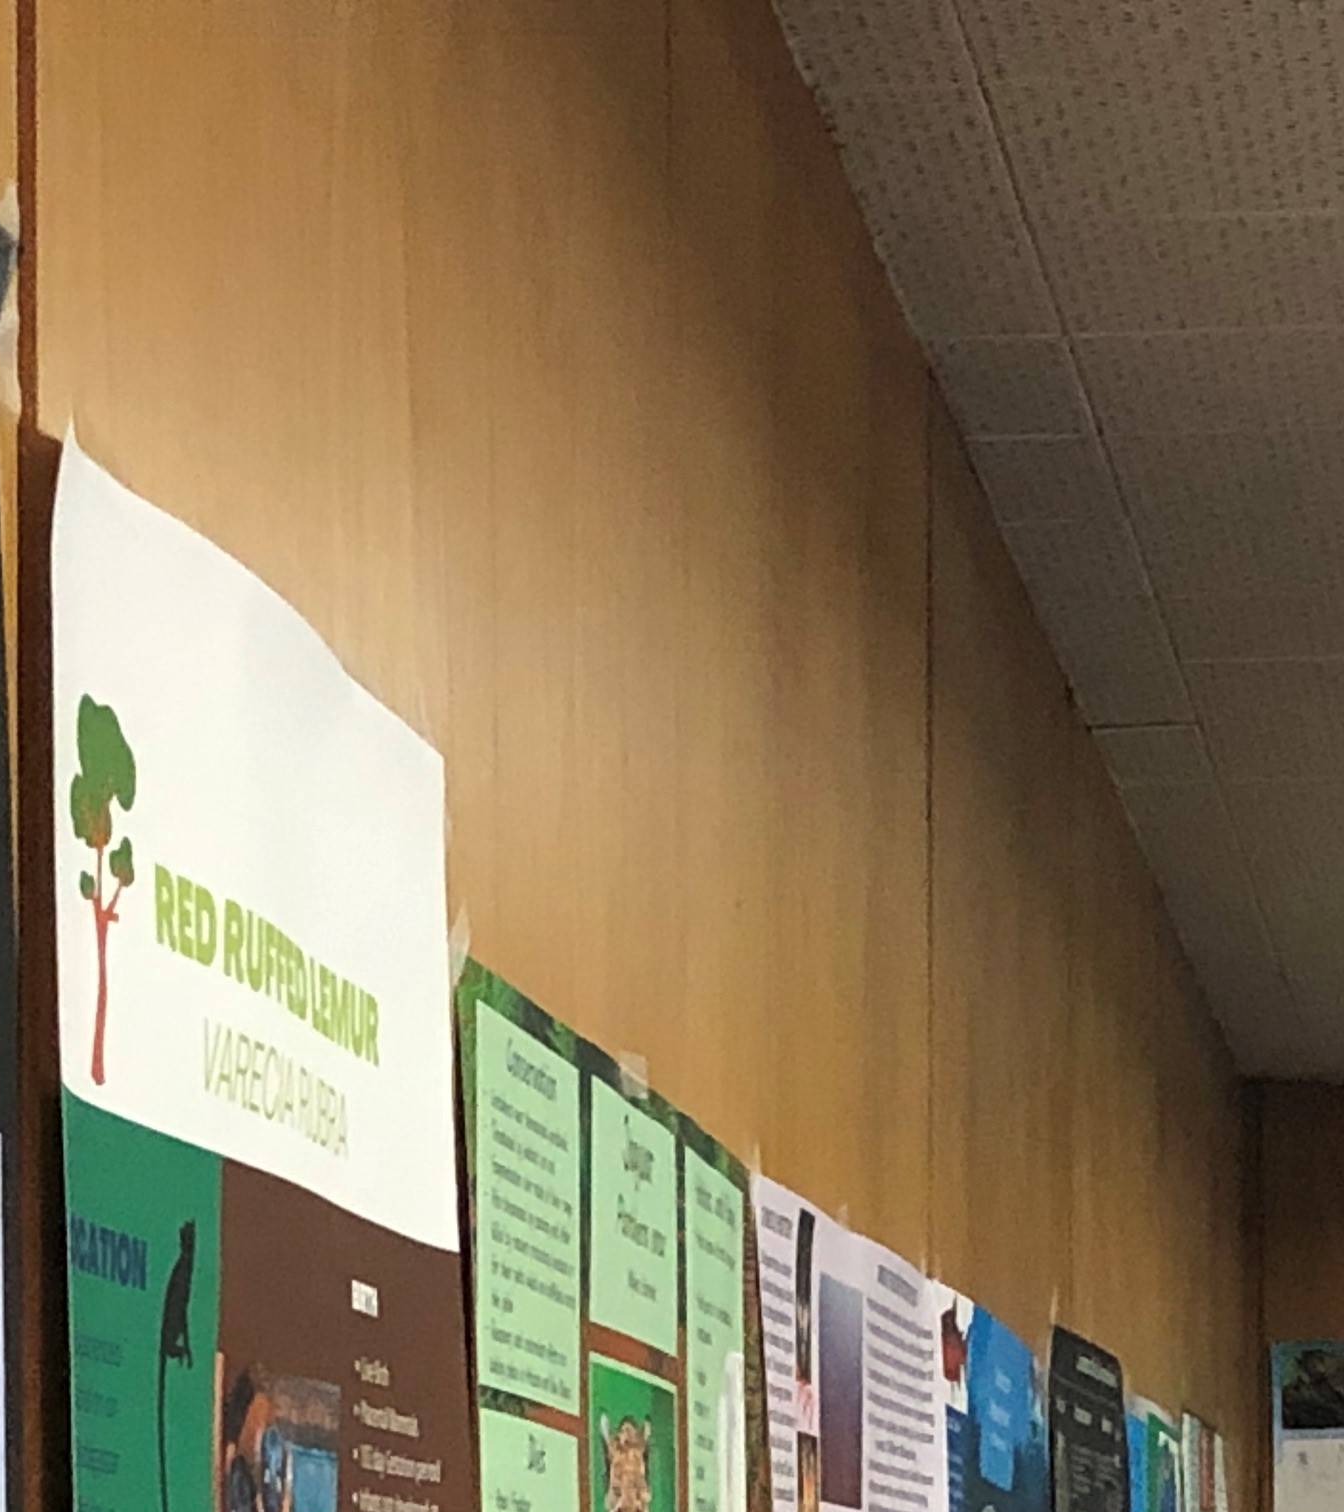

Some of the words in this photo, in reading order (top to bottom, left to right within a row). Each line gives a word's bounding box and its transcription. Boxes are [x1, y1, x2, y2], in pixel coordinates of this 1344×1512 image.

[155, 861, 217, 967] RED
[223, 898, 307, 1023] RUFFED
[309, 955, 380, 1068] LEMUR
